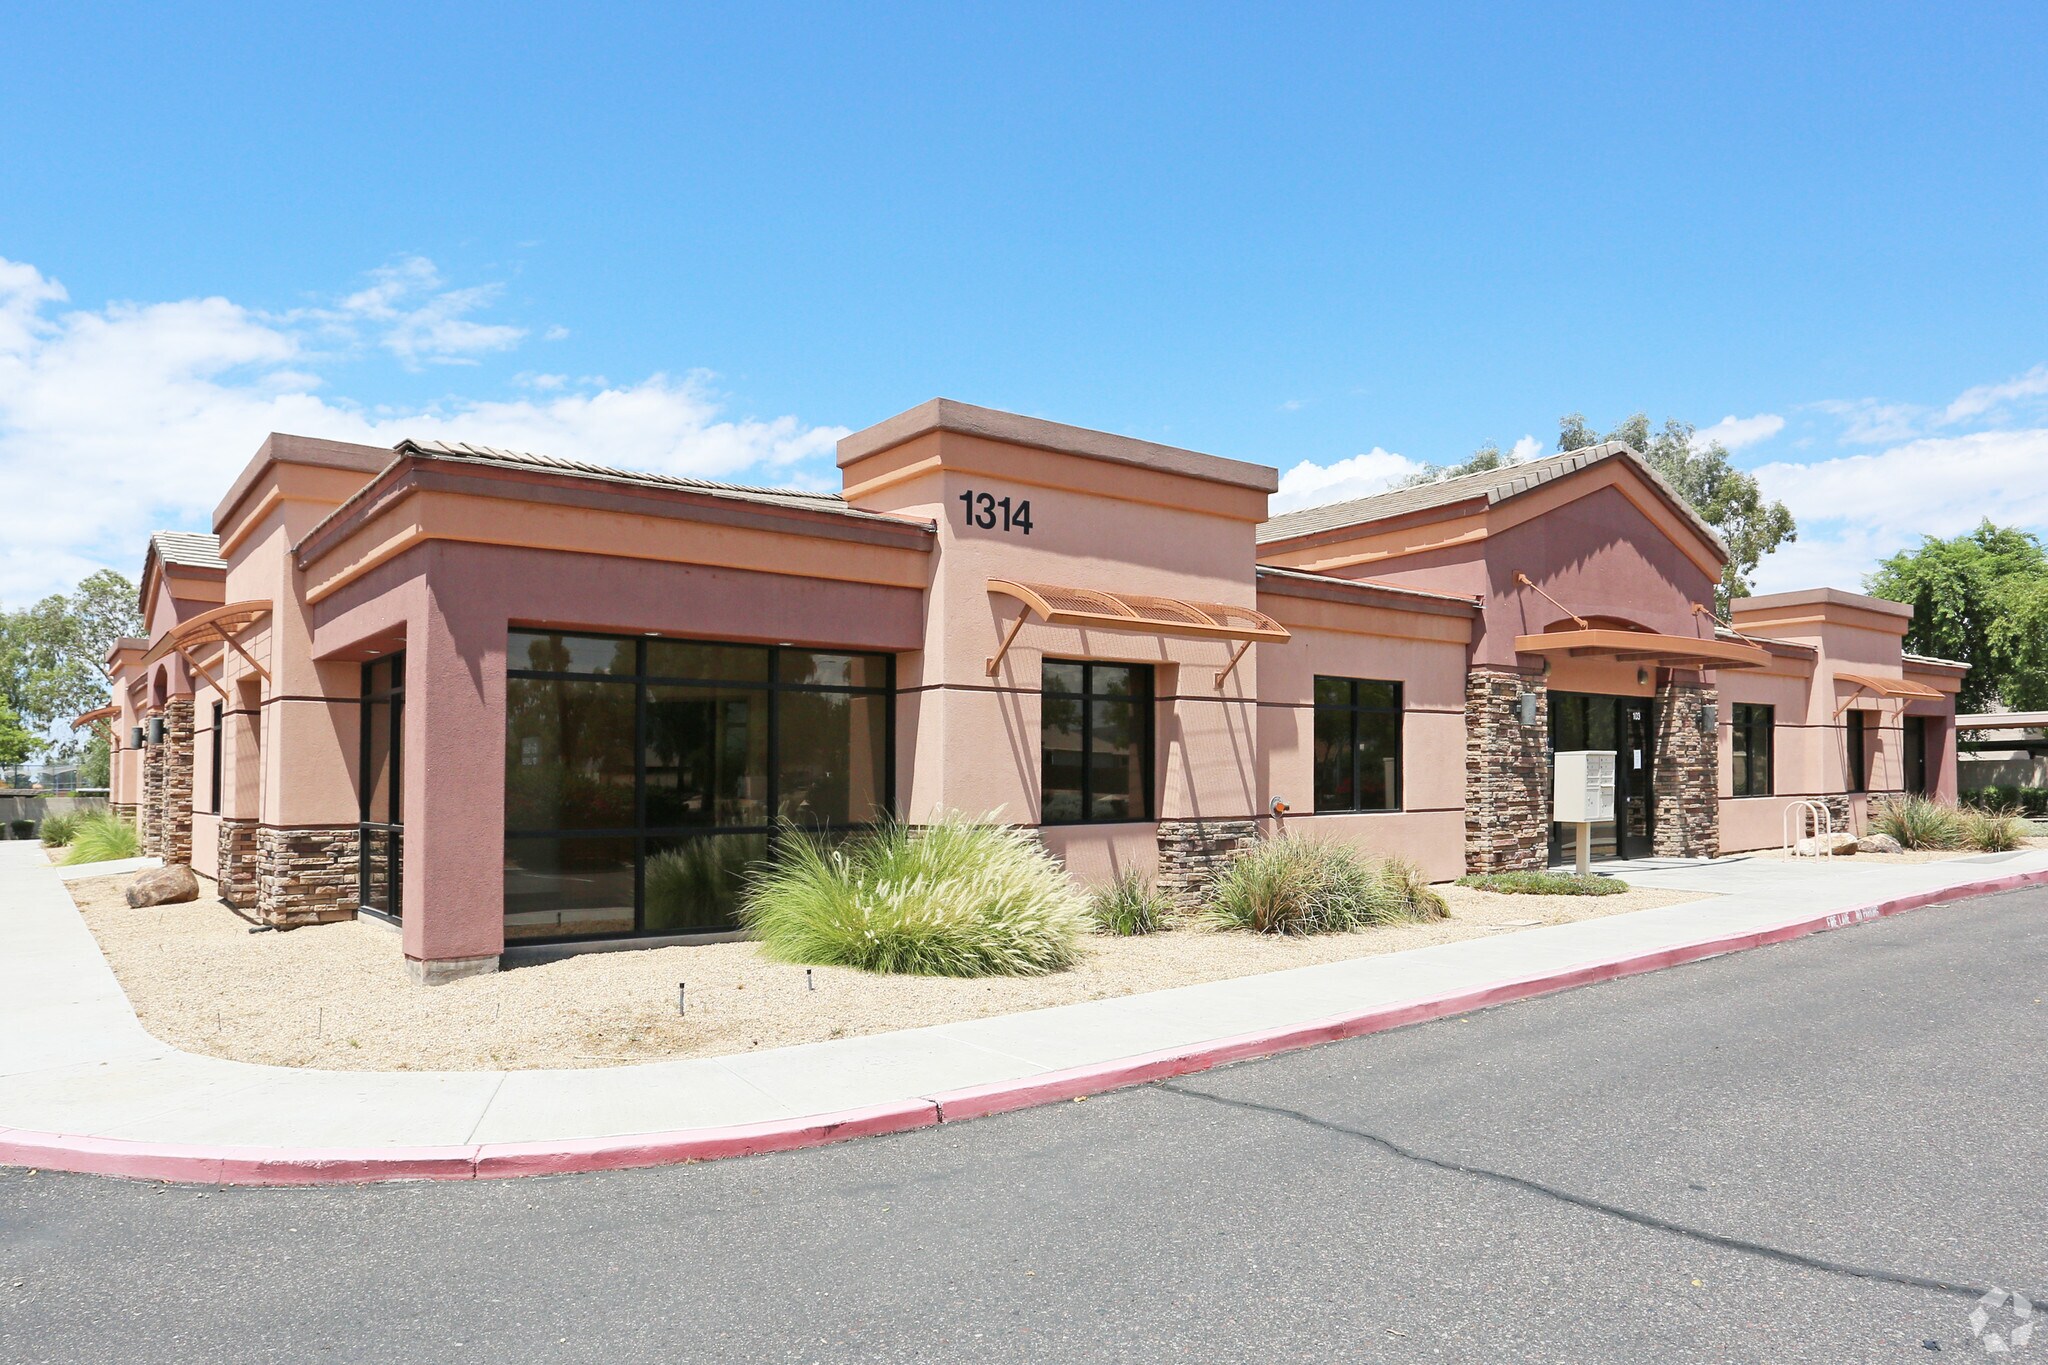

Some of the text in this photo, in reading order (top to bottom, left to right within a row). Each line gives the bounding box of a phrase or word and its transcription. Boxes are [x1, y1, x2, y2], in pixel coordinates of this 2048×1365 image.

[960, 490, 1033, 535] 1314
[1826, 915, 1838, 928] FIRE
[1838, 912, 1851, 926] LANE
